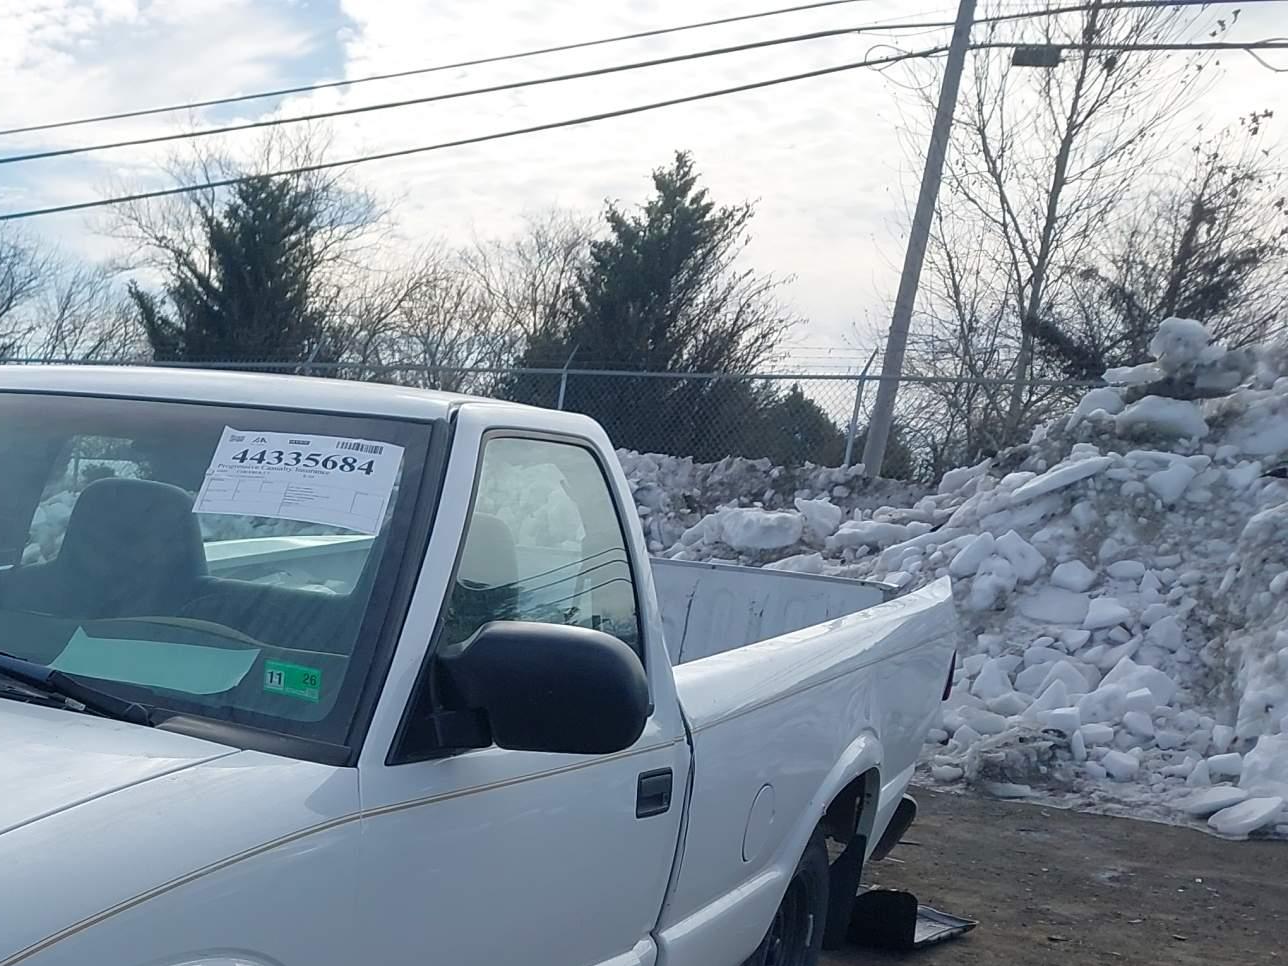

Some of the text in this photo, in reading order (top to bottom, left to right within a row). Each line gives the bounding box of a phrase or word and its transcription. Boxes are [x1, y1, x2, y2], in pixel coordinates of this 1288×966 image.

[217, 463, 259, 471] Progressive
[260, 464, 292, 473] Casualty
[294, 467, 331, 475] Insurance
[231, 448, 375, 476] 44335684
[267, 671, 317, 686] 11 26
